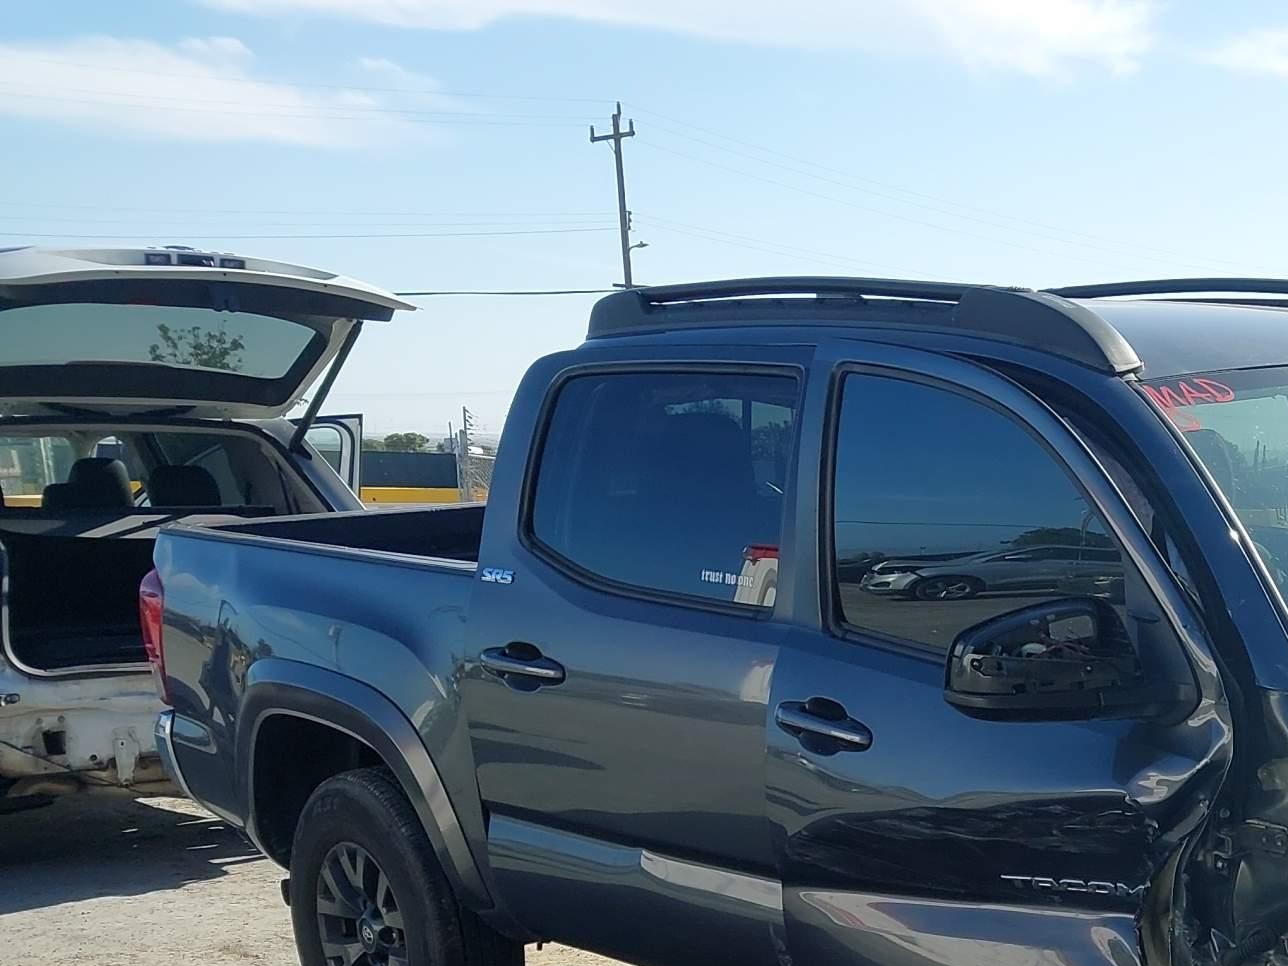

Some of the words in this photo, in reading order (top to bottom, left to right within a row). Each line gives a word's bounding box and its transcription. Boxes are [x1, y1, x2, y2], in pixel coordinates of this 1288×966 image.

[481, 567, 513, 584] SR5
[701, 568, 723, 584] trust
[725, 573, 737, 585] no
[1000, 874, 1150, 897] TACOM
